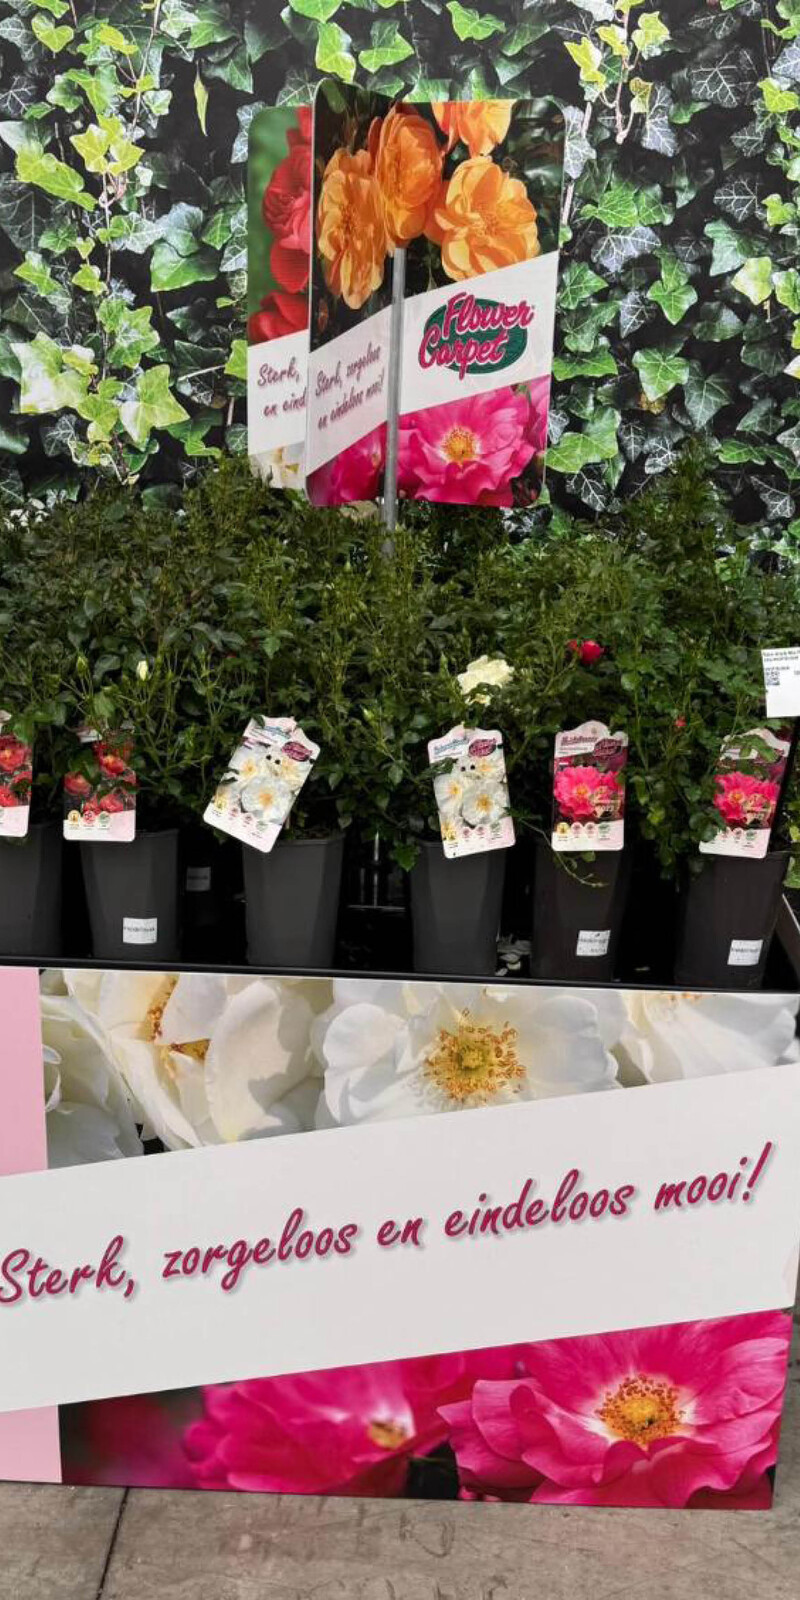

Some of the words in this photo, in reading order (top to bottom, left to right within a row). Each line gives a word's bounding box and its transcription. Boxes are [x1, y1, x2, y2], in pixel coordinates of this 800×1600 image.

[443, 291, 533, 340] Flower
[257, 356, 299, 387] Sterk,
[418, 328, 509, 380] Carpet
[263, 403, 277, 416] en
[0, 1235, 136, 1305] Sterk,
[162, 1207, 358, 1292] zorgeloos
[376, 1216, 421, 1248] en
[444, 1169, 636, 1239] eindeloos
[654, 1142, 773, 1209] mooi!
